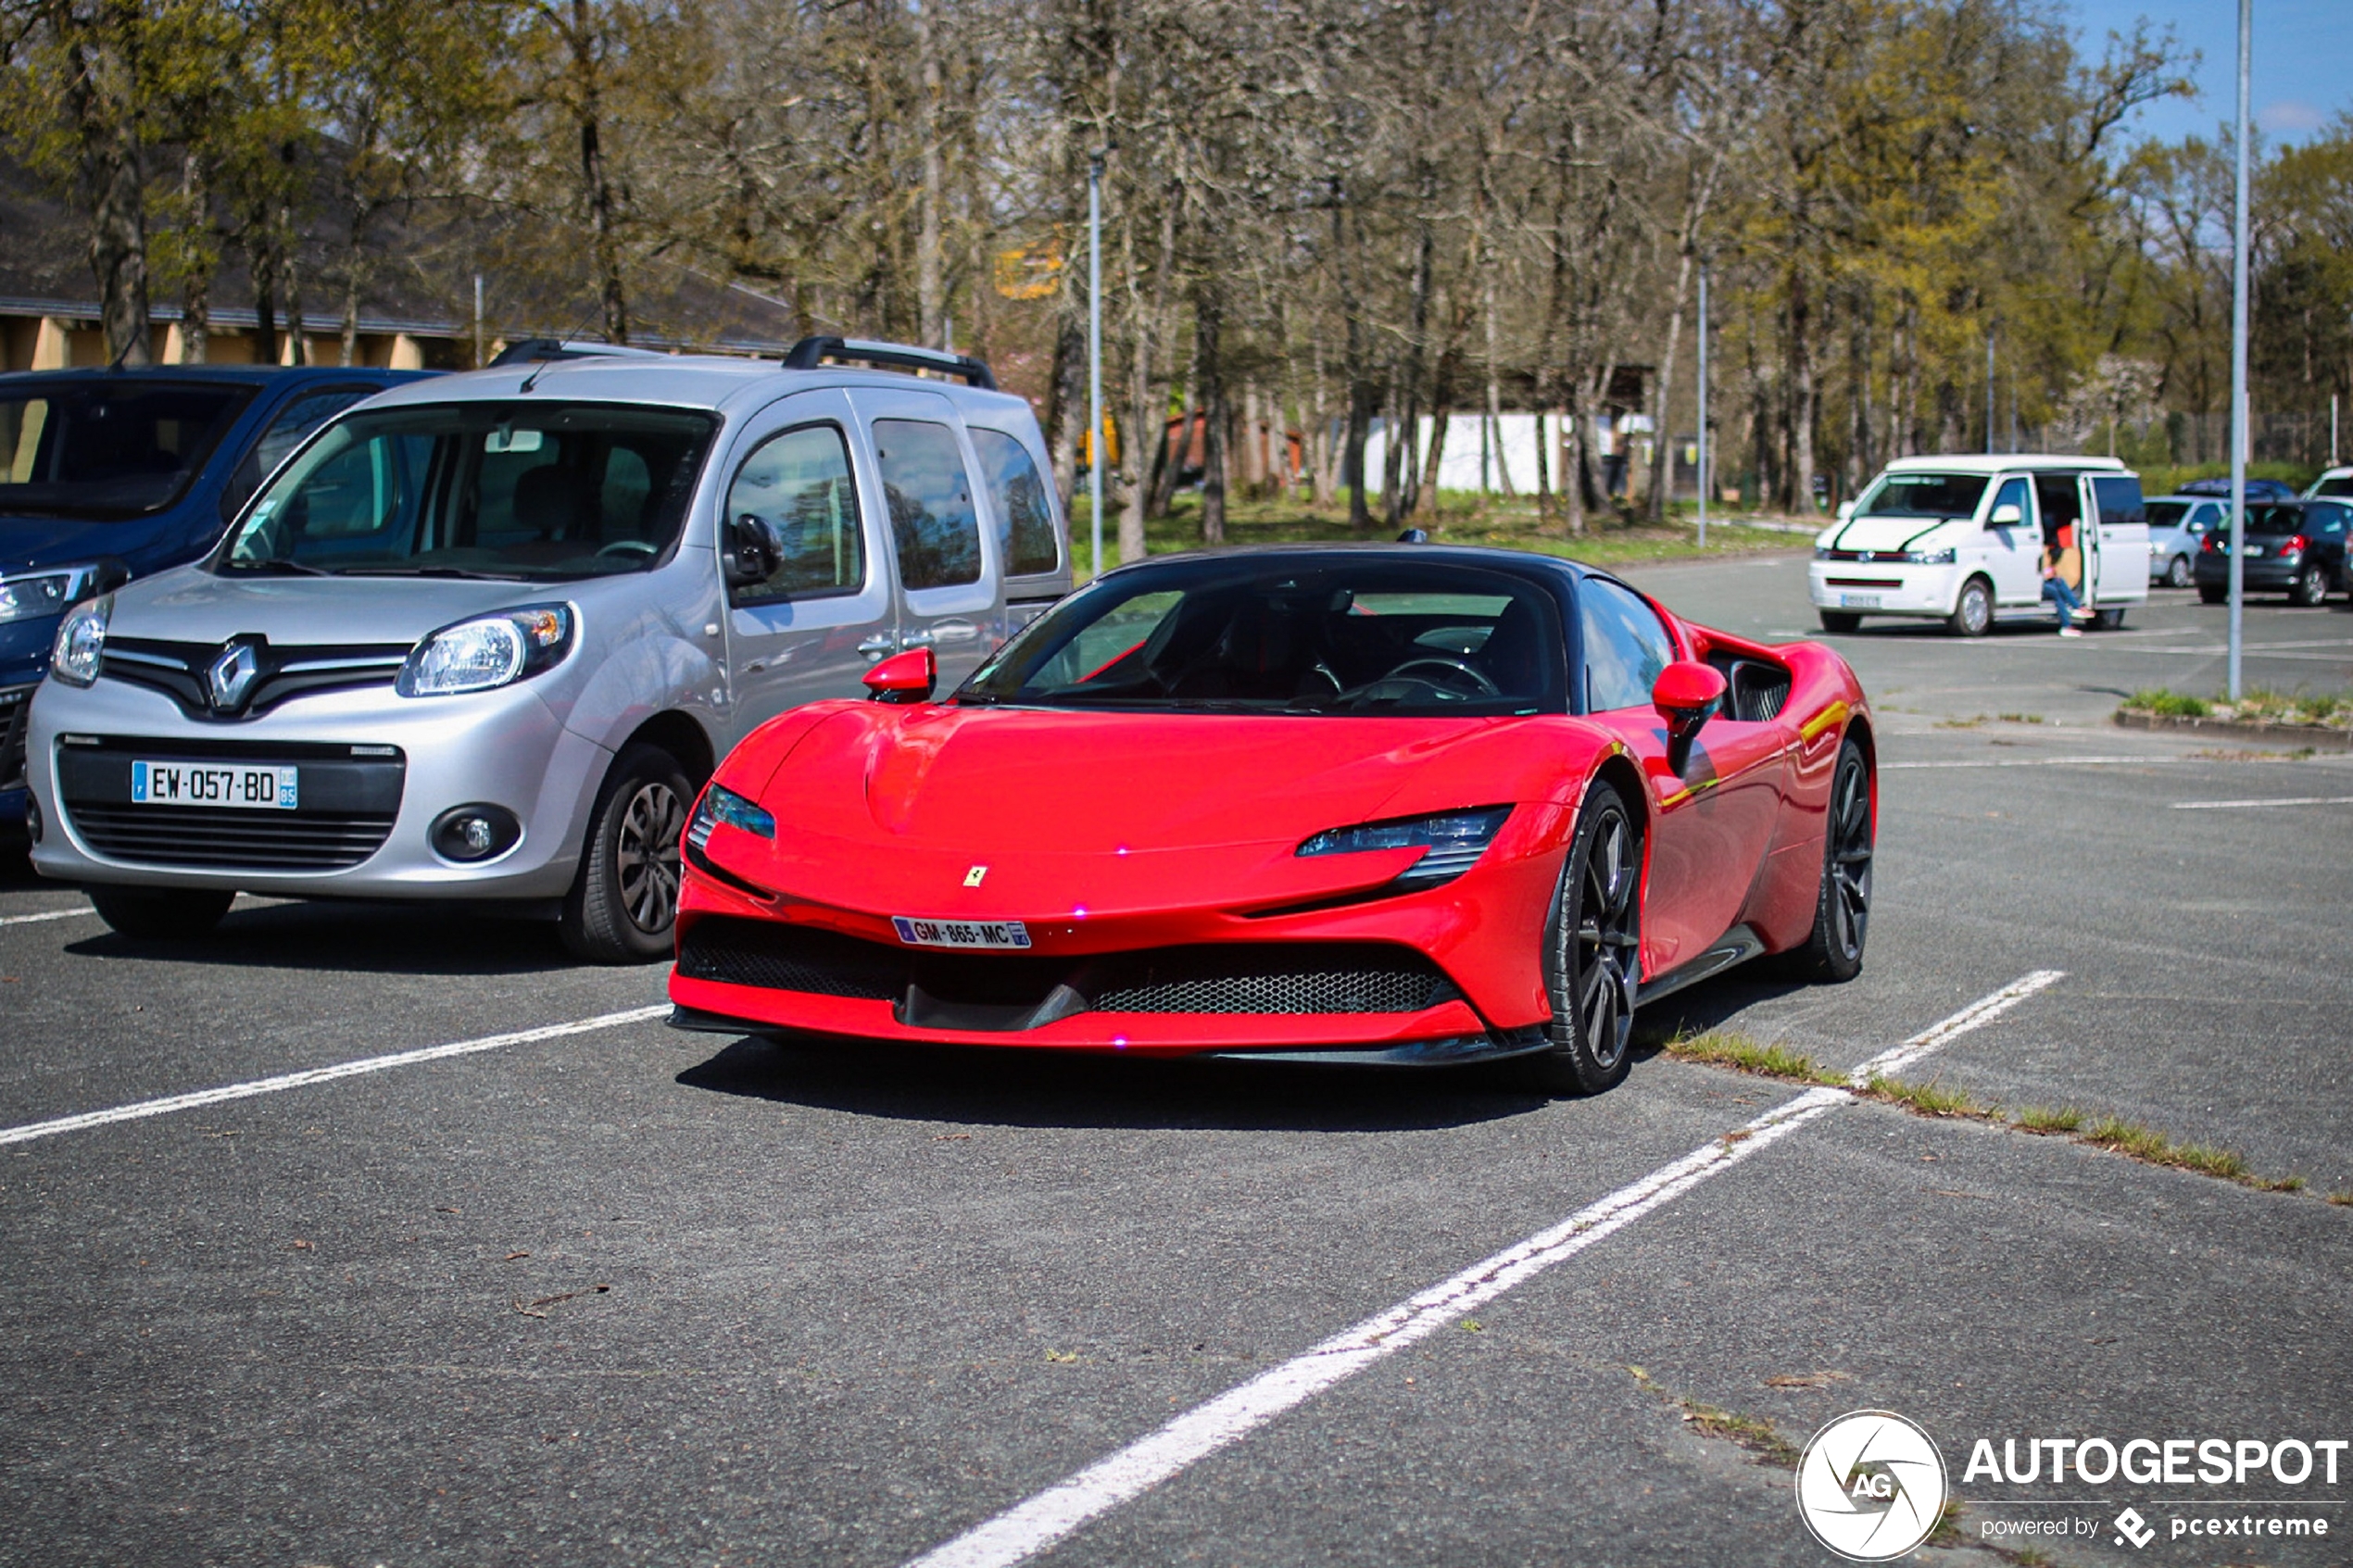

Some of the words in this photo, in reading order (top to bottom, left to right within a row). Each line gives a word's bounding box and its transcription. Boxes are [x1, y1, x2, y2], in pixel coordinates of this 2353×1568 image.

[152, 768, 274, 803] EW-057-BD
[280, 788, 296, 804] 85
[913, 922, 1009, 944] GM-865-MC
